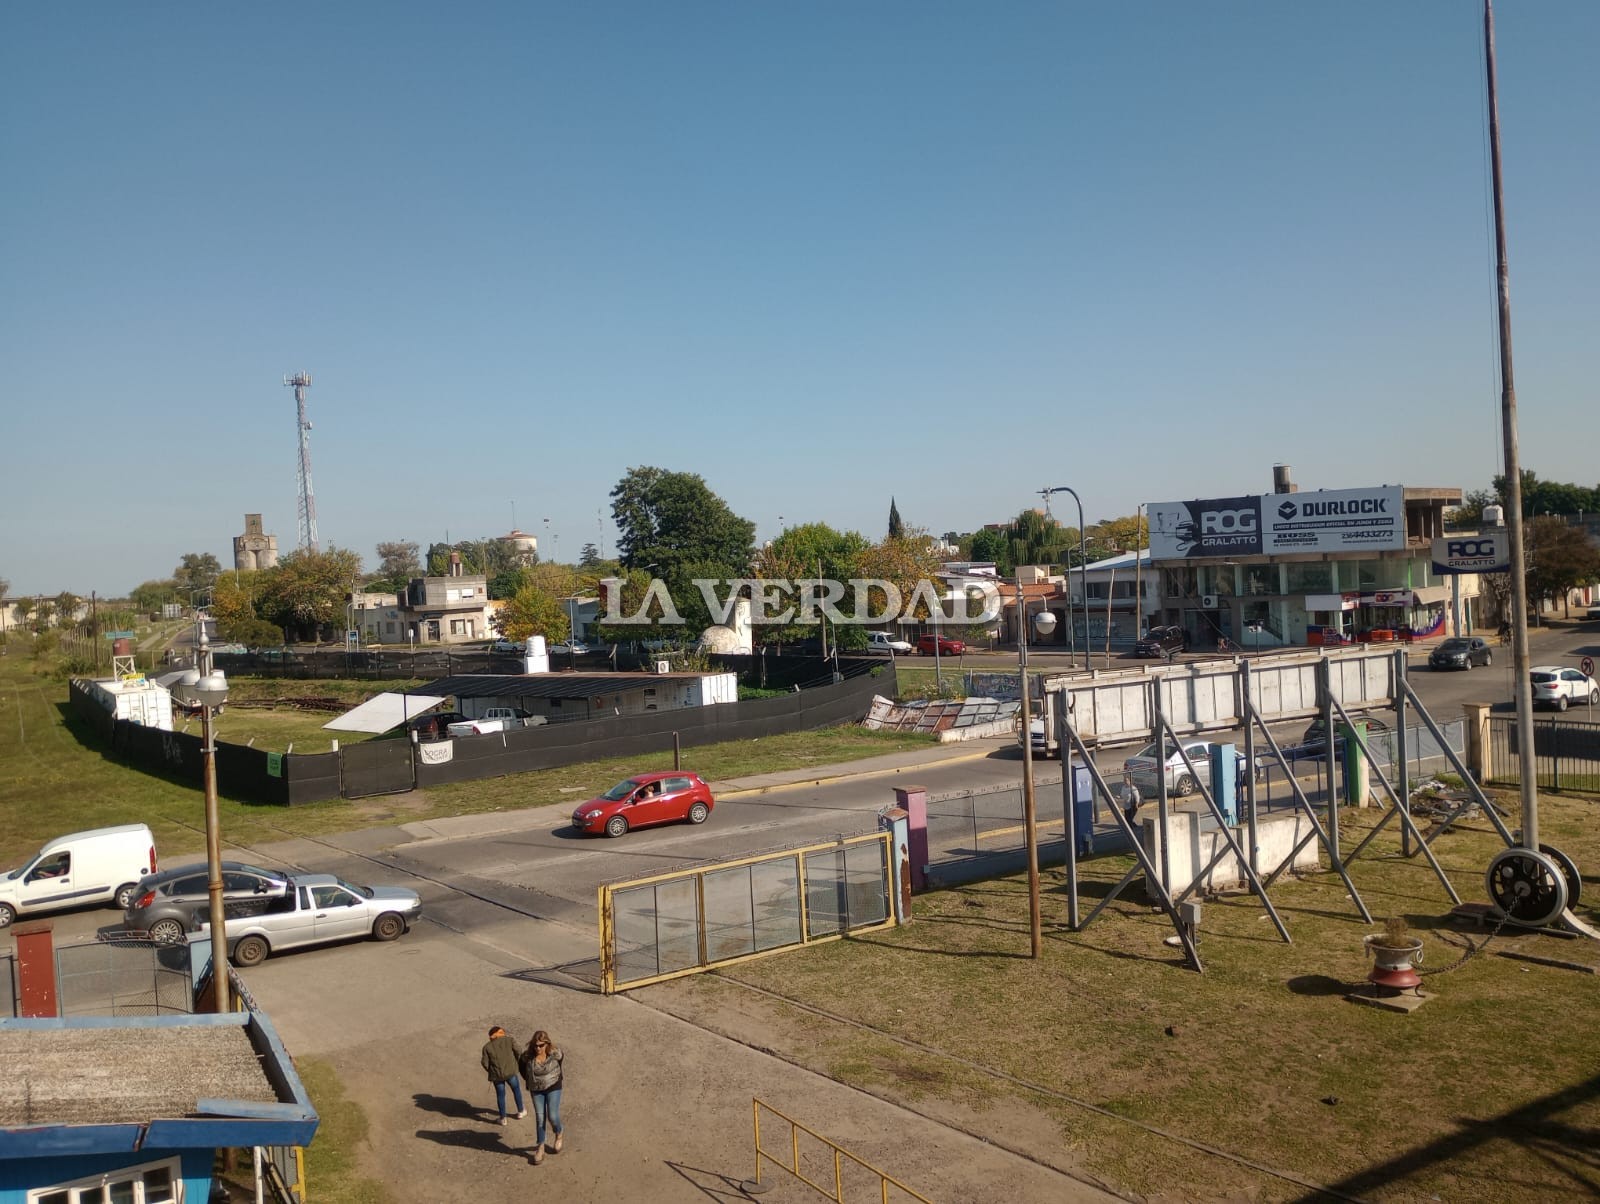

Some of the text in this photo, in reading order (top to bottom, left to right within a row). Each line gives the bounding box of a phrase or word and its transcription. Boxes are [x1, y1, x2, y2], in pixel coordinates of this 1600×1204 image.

[1303, 498, 1387, 517] DURLOCK
[1201, 508, 1257, 534] ROG
[1202, 536, 1257, 546] GRALATTO
[1448, 540, 1495, 557] ROG
[1448, 559, 1496, 567] GRALATTO
